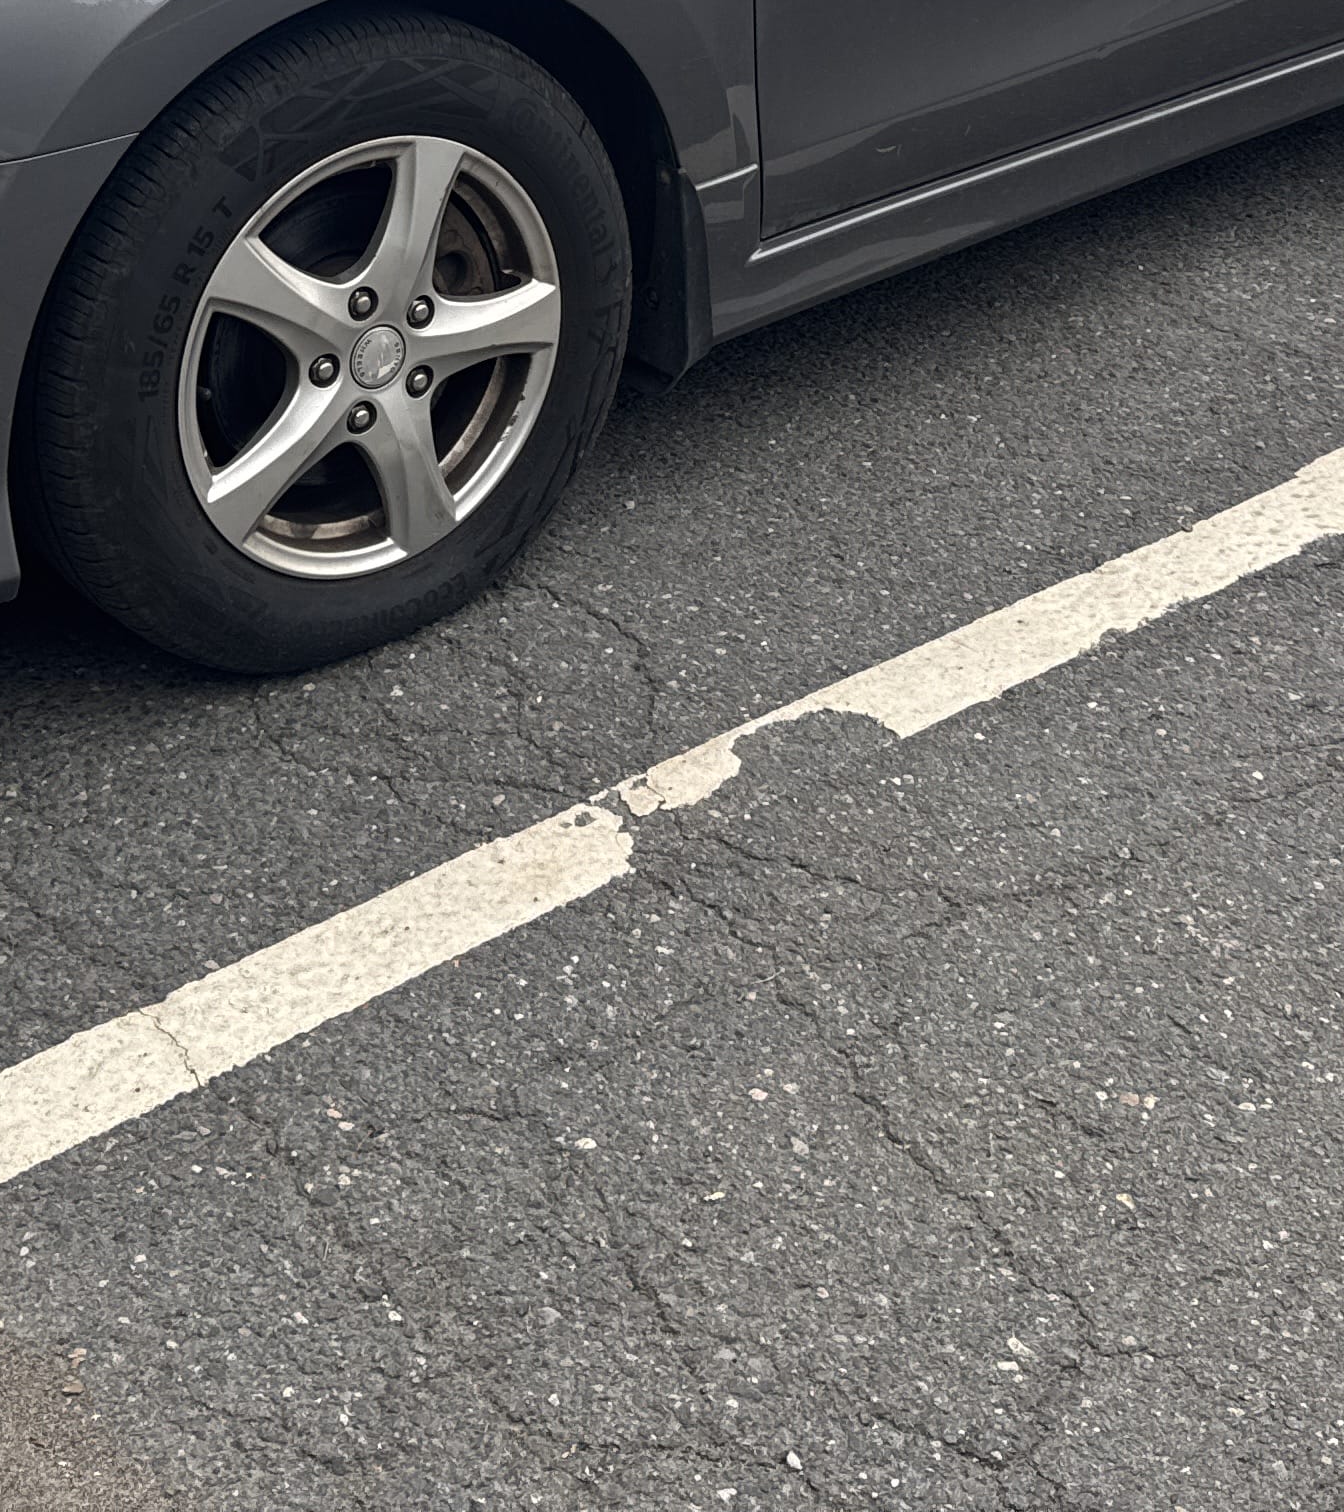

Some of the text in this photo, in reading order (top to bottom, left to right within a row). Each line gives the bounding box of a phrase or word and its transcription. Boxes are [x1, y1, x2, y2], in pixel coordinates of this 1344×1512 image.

[137, 195, 233, 403] 185/65 R 15 T
